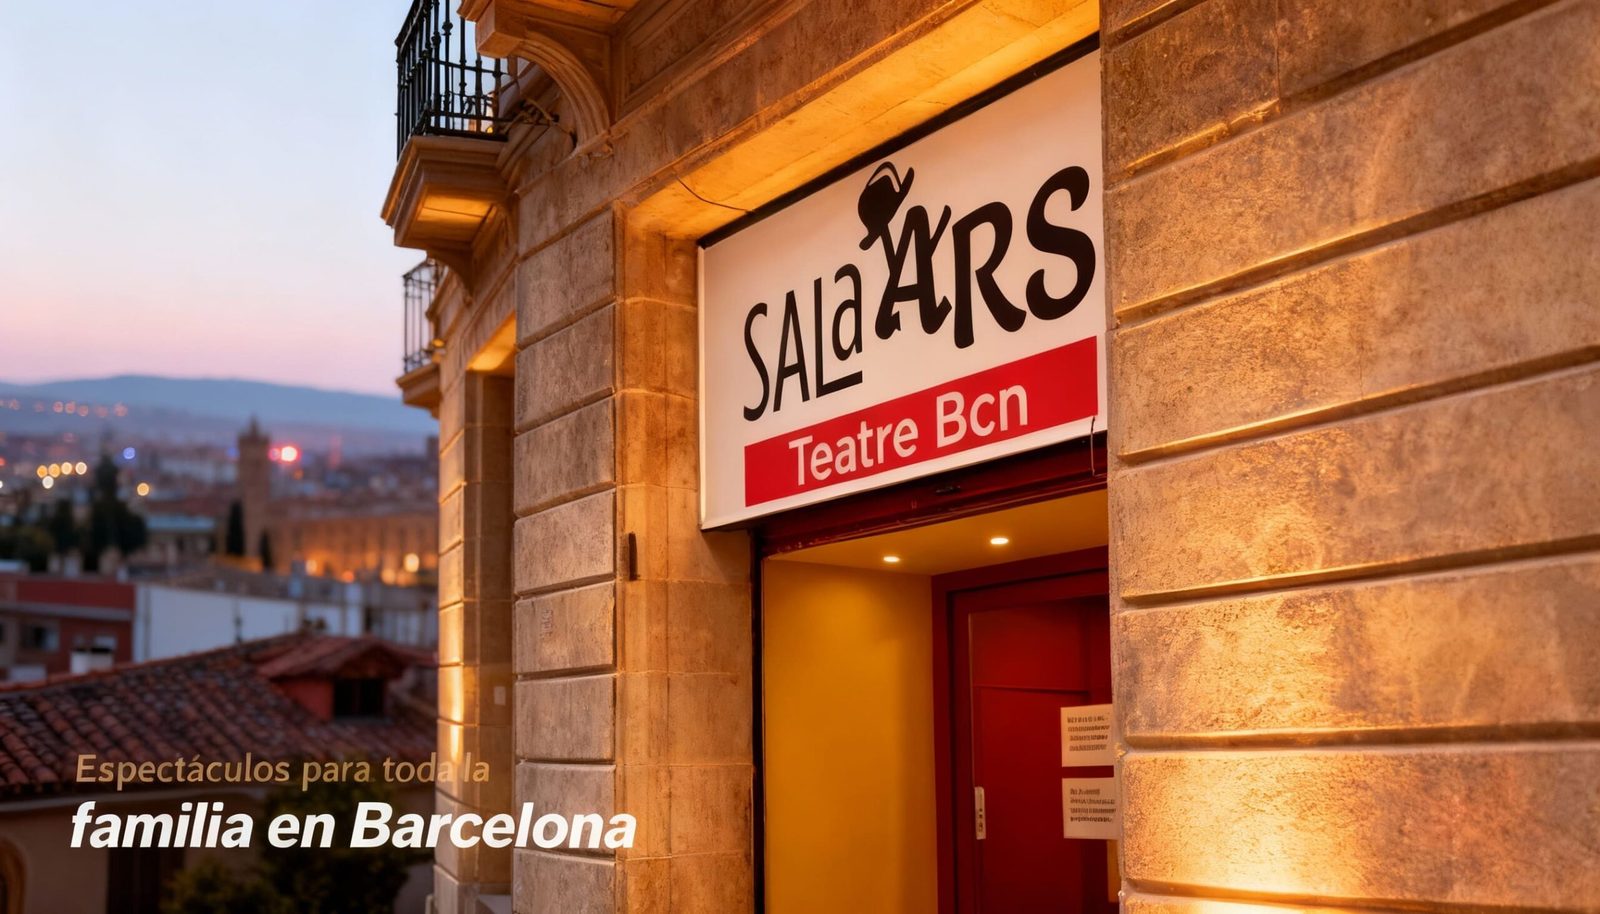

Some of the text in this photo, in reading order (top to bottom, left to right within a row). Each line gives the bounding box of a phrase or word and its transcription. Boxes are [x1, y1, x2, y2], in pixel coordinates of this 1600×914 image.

[873, 165, 1096, 349] ARS
[788, 383, 1028, 486] Teatre Bcn
